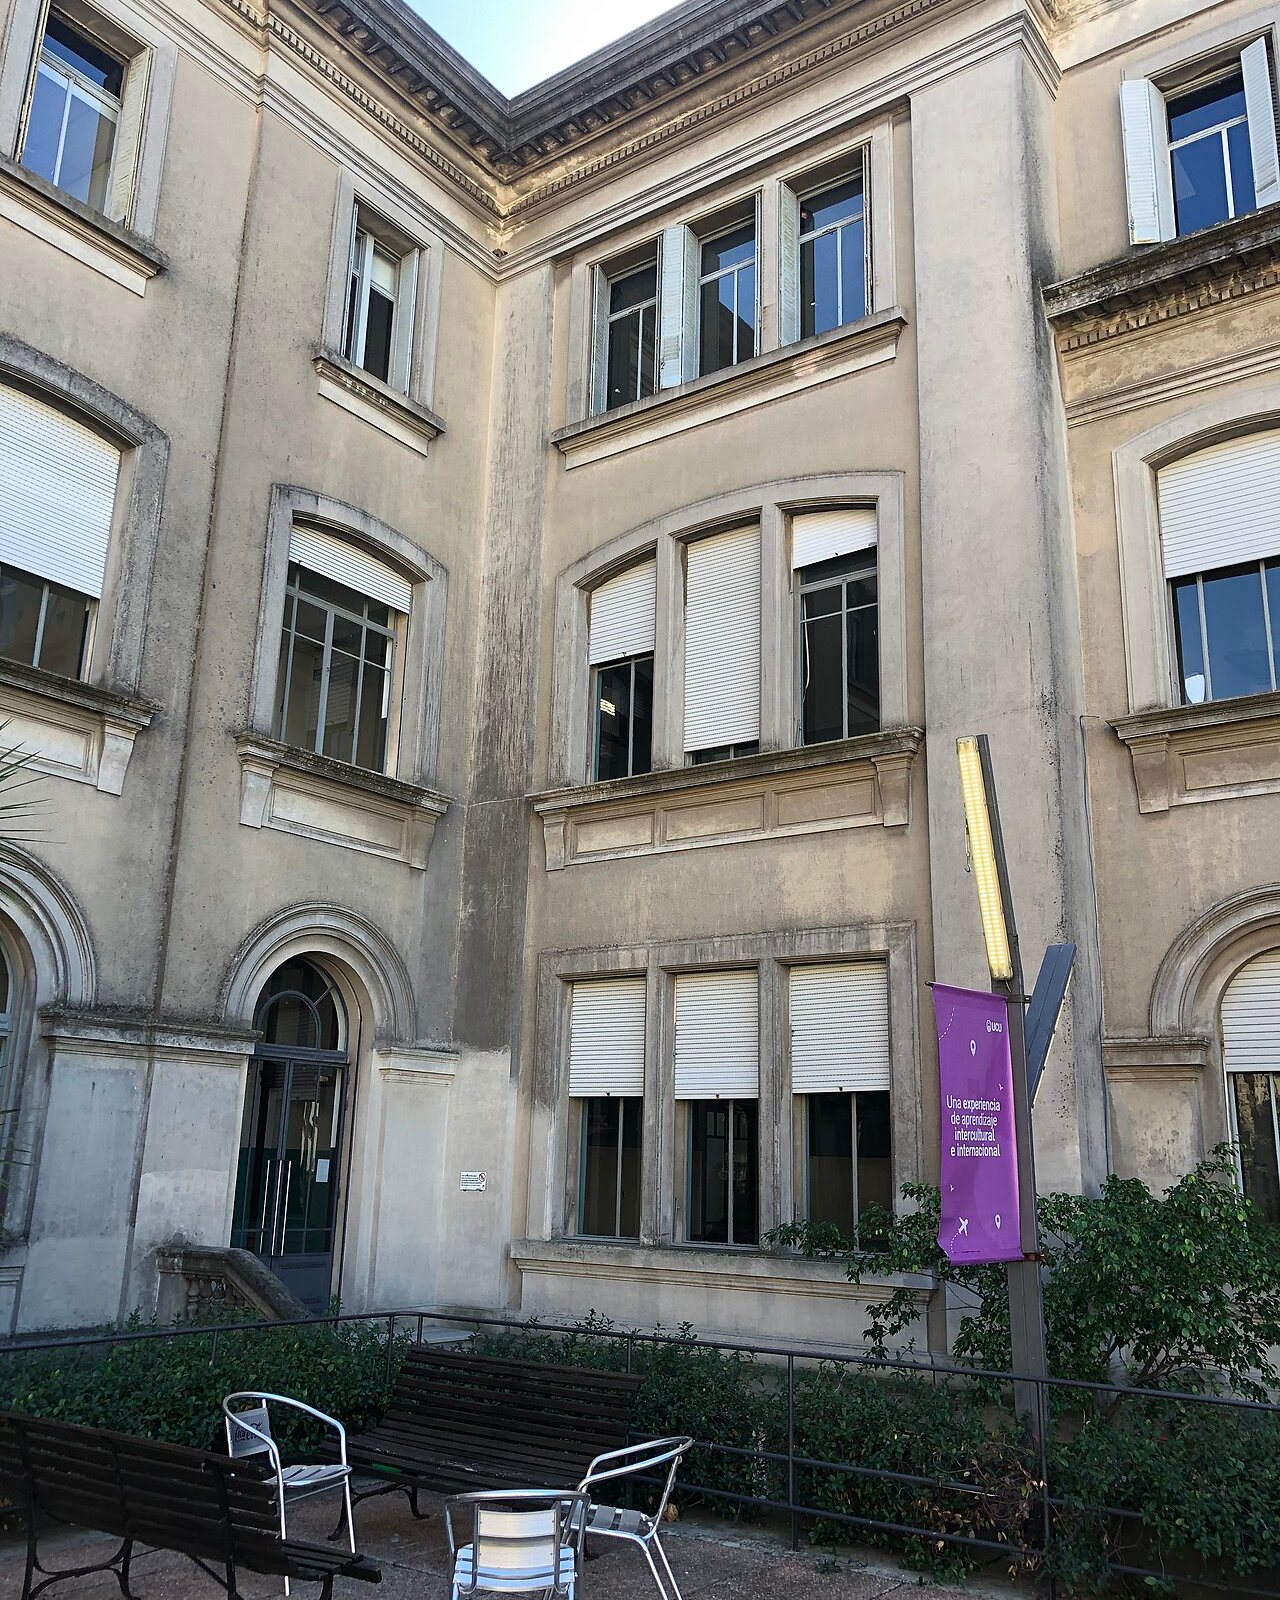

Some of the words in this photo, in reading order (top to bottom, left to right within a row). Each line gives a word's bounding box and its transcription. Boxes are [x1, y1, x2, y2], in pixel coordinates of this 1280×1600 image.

[946, 1094, 962, 1109] Una
[963, 1097, 1000, 1112] experiencia
[951, 1111, 960, 1125] de
[961, 1113, 997, 1129] aprendizaje
[954, 1127, 995, 1141] intercultural
[950, 1146, 956, 1157] e
[957, 1143, 1000, 1157] internacional
